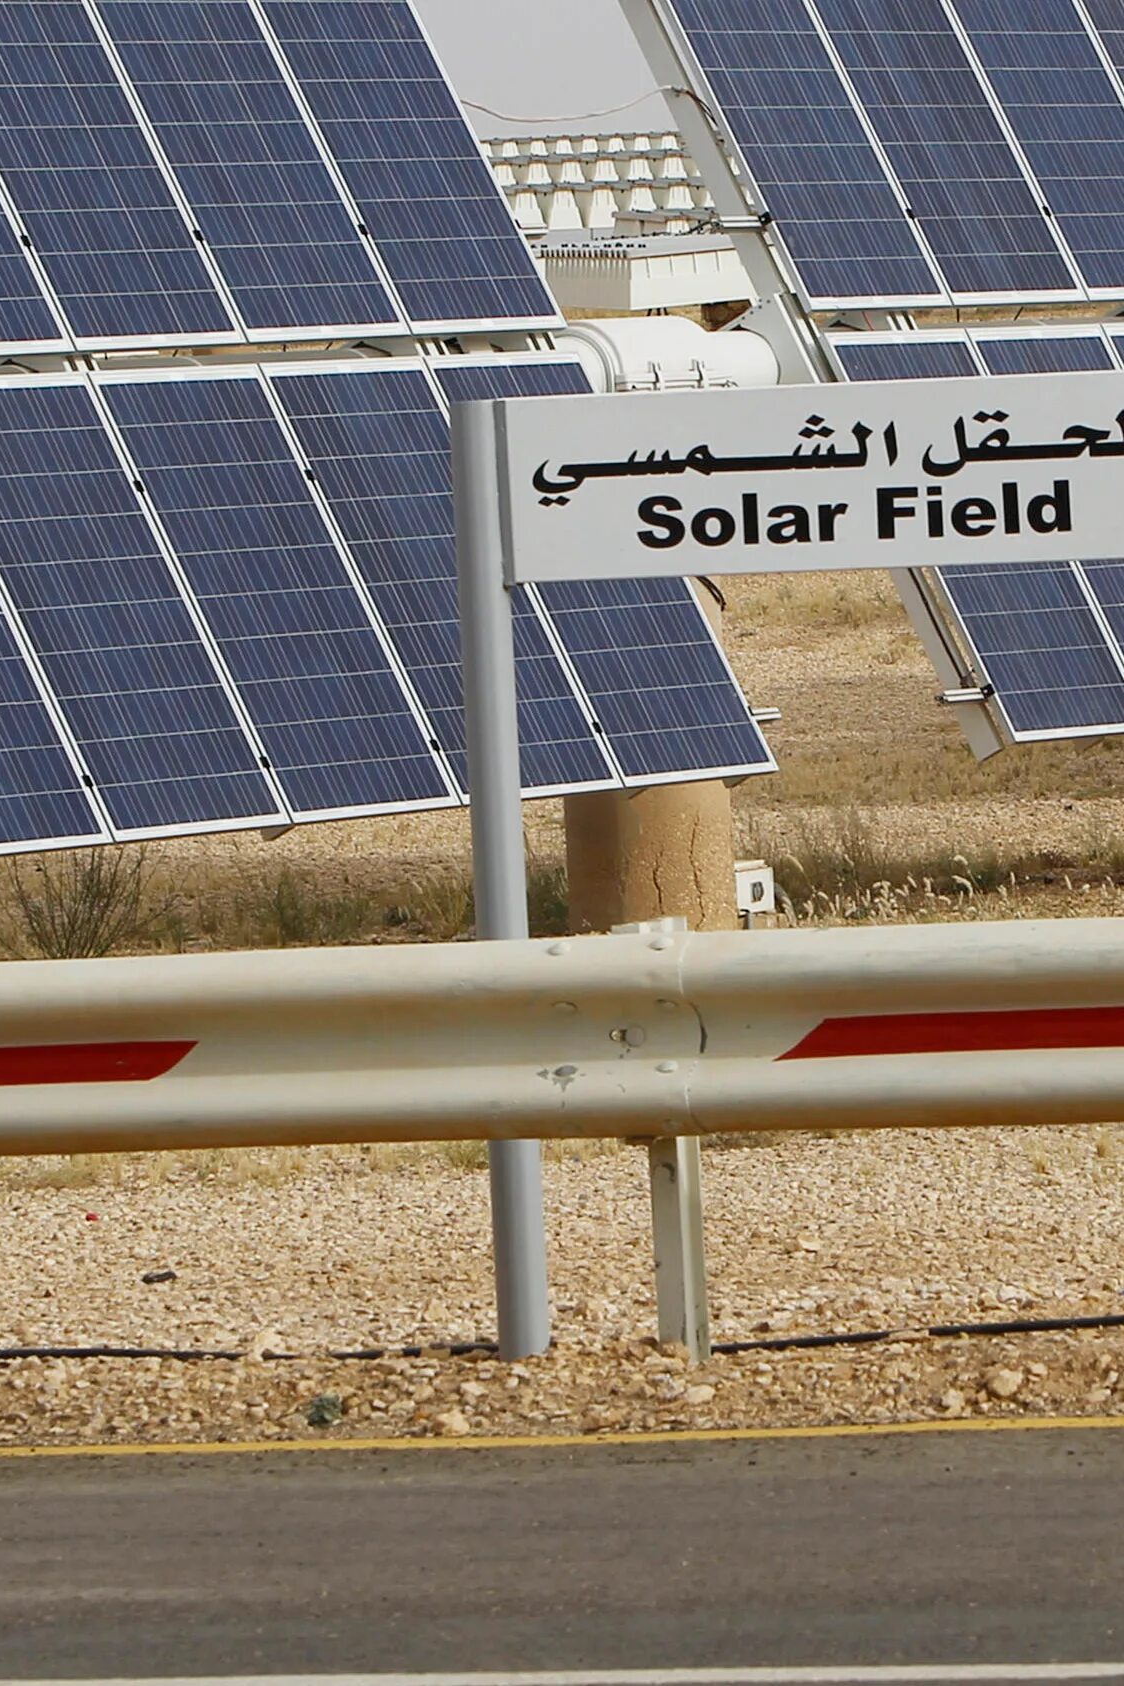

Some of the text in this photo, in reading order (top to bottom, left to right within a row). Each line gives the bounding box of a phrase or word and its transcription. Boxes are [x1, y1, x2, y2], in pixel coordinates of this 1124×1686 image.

[532, 414, 898, 507] الشمسي
[637, 479, 1072, 549] Solar Field
